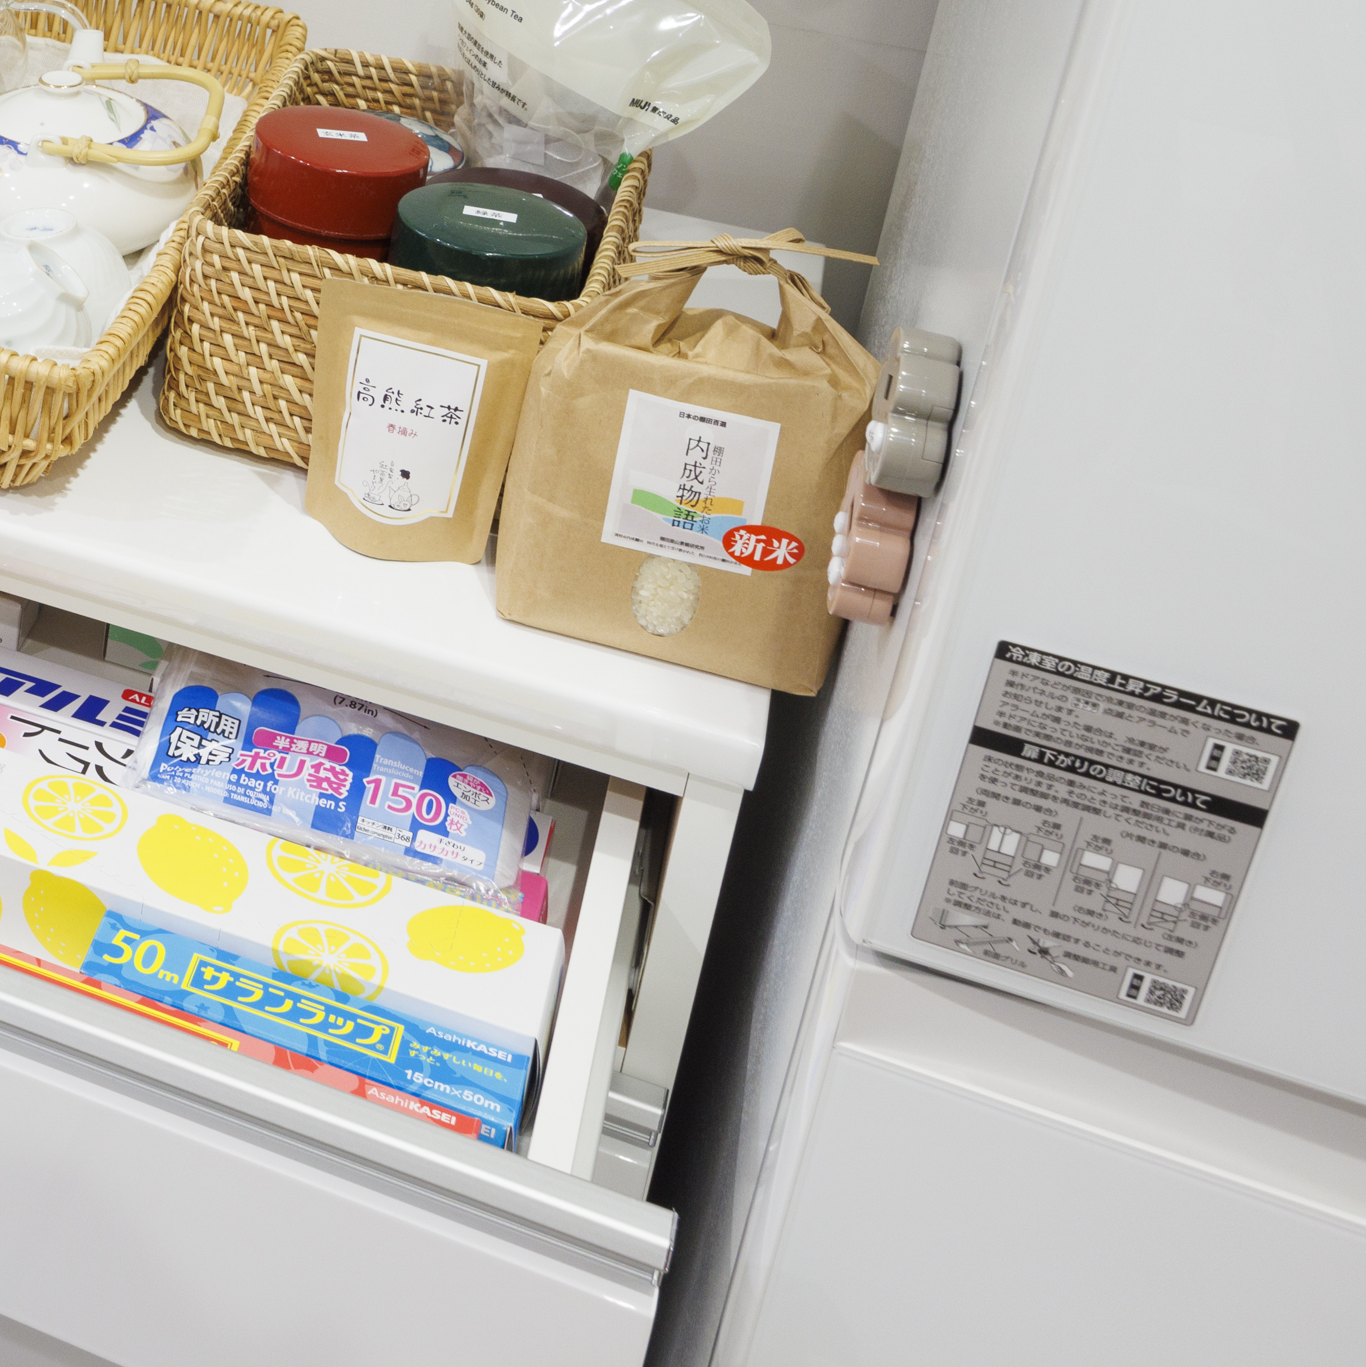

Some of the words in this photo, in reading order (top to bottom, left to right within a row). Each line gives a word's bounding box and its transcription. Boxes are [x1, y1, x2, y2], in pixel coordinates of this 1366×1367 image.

[509, 9, 524, 24] Tea
[628, 97, 650, 113] MUJI
[356, 377, 465, 426] 高熊紅茶
[386, 422, 419, 439] 春摘み
[671, 435, 711, 532] 内成物語
[697, 444, 725, 535] 棚田から生れたお米
[727, 528, 800, 566] 新米
[1004, 644, 1289, 736] 冷凍室の温度上昇アラームについて
[332, 694, 379, 719] (7.87in)
[1001, 690, 1080, 720] お知らせします。
[176, 707, 241, 740] 台所用
[167, 726, 234, 766] 保存
[272, 736, 328, 758] 半透明
[233, 750, 353, 799] ポリ袋
[372, 763, 414, 780] Translúcido
[374, 753, 424, 778] Translucent
[1019, 743, 1213, 809] 扉下がりの調整について
[159, 762, 238, 783] Polyethylene
[241, 773, 265, 792] bag
[266, 780, 286, 794] for
[286, 784, 335, 810] Kitchen
[337, 801, 347, 813] S
[209, 777, 225, 788] PARA
[224, 781, 237, 791] USO
[236, 785, 247, 794] DE
[452, 782, 491, 805] エンボス
[230, 792, 268, 809] TRANSLÚCIDO
[364, 777, 445, 825] 150
[460, 792, 481, 808] 加工
[959, 802, 989, 817] 下がり
[395, 832, 411, 844] 368
[447, 819, 466, 835] 枚
[1034, 824, 1065, 840] 下がり
[416, 840, 461, 860] カサカサ
[460, 855, 484, 867] タイプ
[437, 837, 466, 852] 手ざわり
[1084, 839, 1115, 855] 下がり
[1202, 874, 1233, 891] 下がり
[946, 887, 1010, 915] してください。
[102, 929, 180, 986] 50m
[200, 964, 391, 1045] サランラップ
[407, 1048, 441, 1068] ずっと。
[407, 1040, 510, 1083] みずみずしい毎日を、
